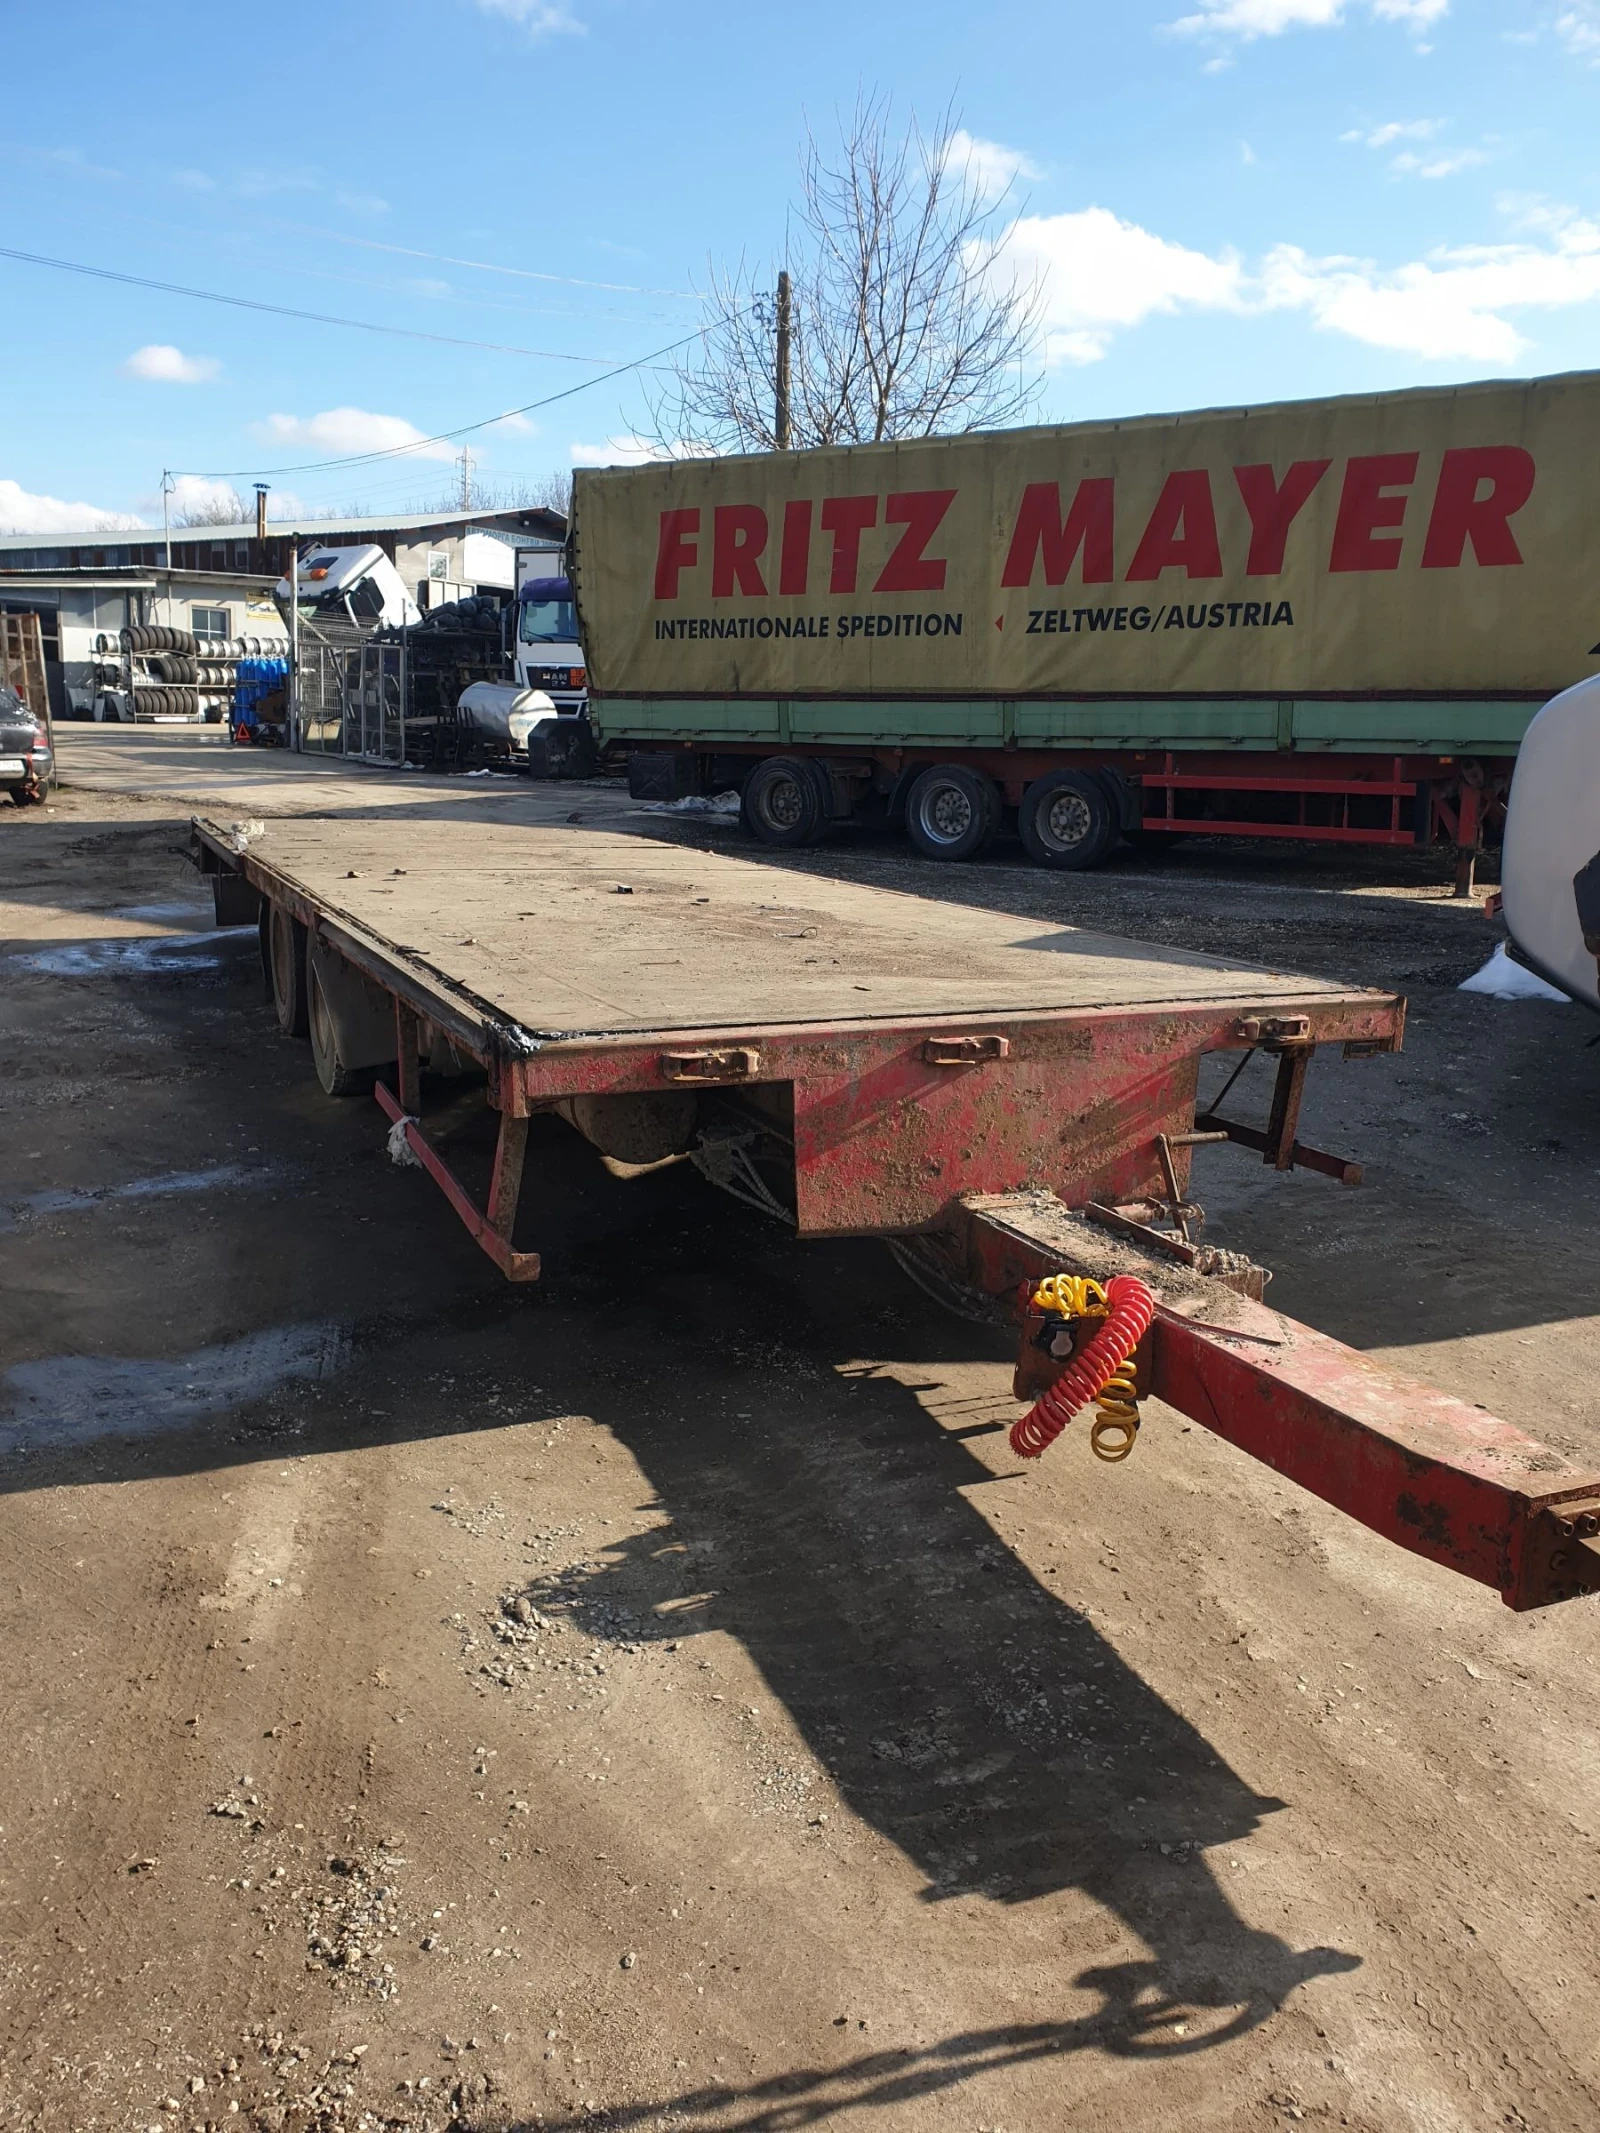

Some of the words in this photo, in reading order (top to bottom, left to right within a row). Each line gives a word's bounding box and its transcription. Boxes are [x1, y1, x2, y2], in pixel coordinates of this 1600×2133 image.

[654, 488, 959, 600] FRITZ
[1000, 445, 1536, 588] MAYER
[655, 616, 829, 640] INTERNATIONALE
[836, 613, 963, 638] SPEDITION
[1025, 601, 1294, 634] ZELTWEG/AUSTRIA
